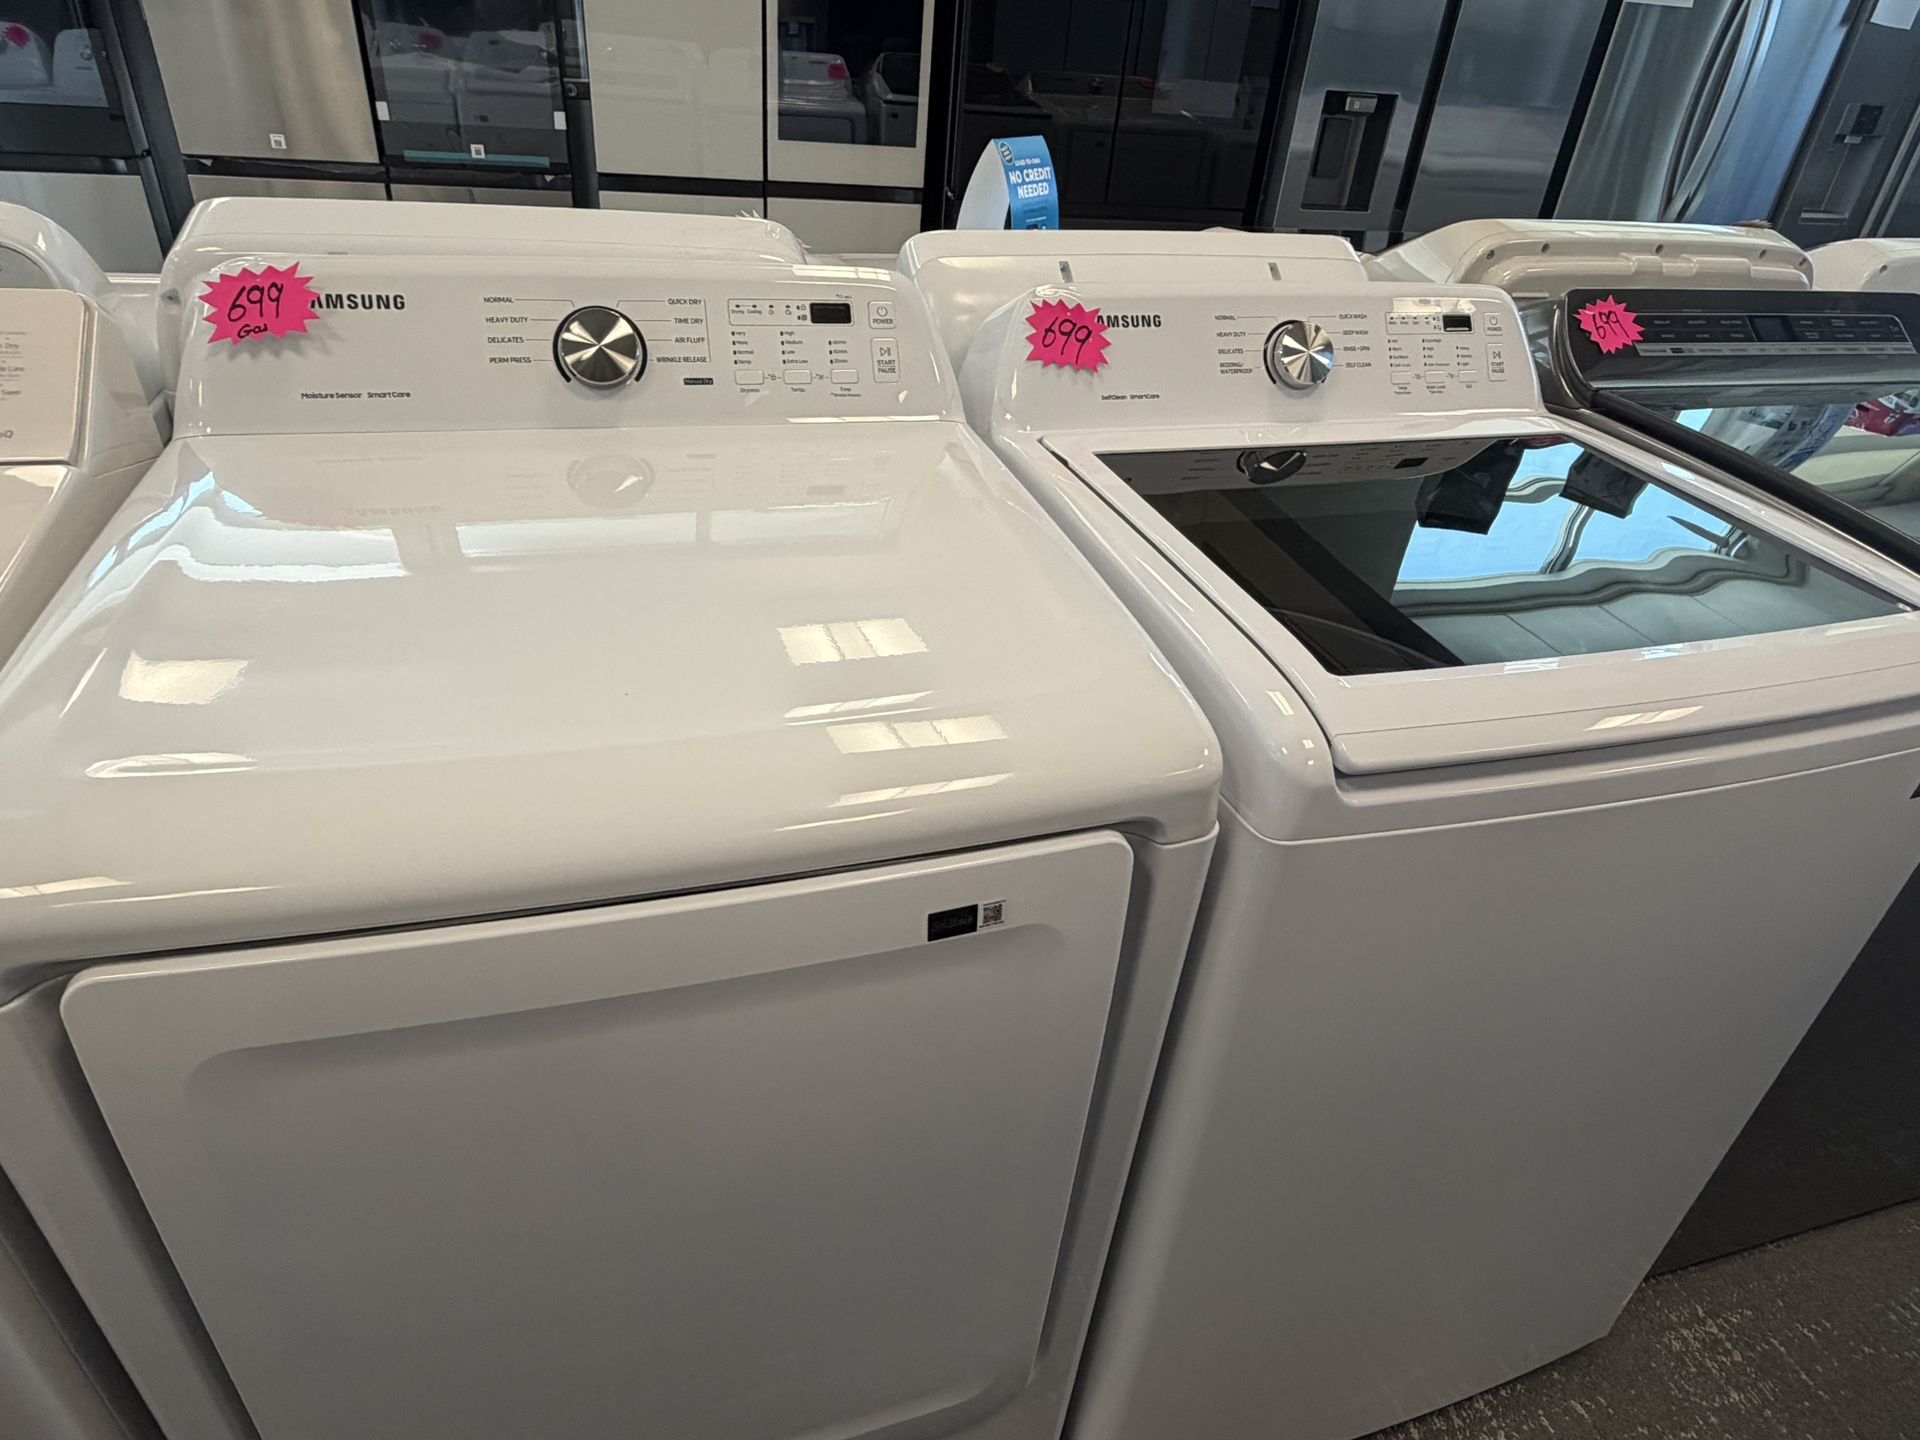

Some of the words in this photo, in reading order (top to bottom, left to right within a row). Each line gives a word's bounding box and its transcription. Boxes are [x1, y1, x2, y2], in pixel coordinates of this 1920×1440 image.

[1008, 170, 1023, 184] NO
[1023, 166, 1052, 182] CREDIT
[1017, 182, 1049, 199] NEEDED
[227, 281, 284, 323] 699
[310, 294, 406, 311] AMSUNG
[1096, 315, 1162, 328] AMSUNG
[1592, 310, 1631, 340] 699
[237, 323, 269, 339] Gas
[1042, 316, 1093, 365] 699
[301, 391, 334, 399] Moisture
[335, 391, 362, 399] Sensor
